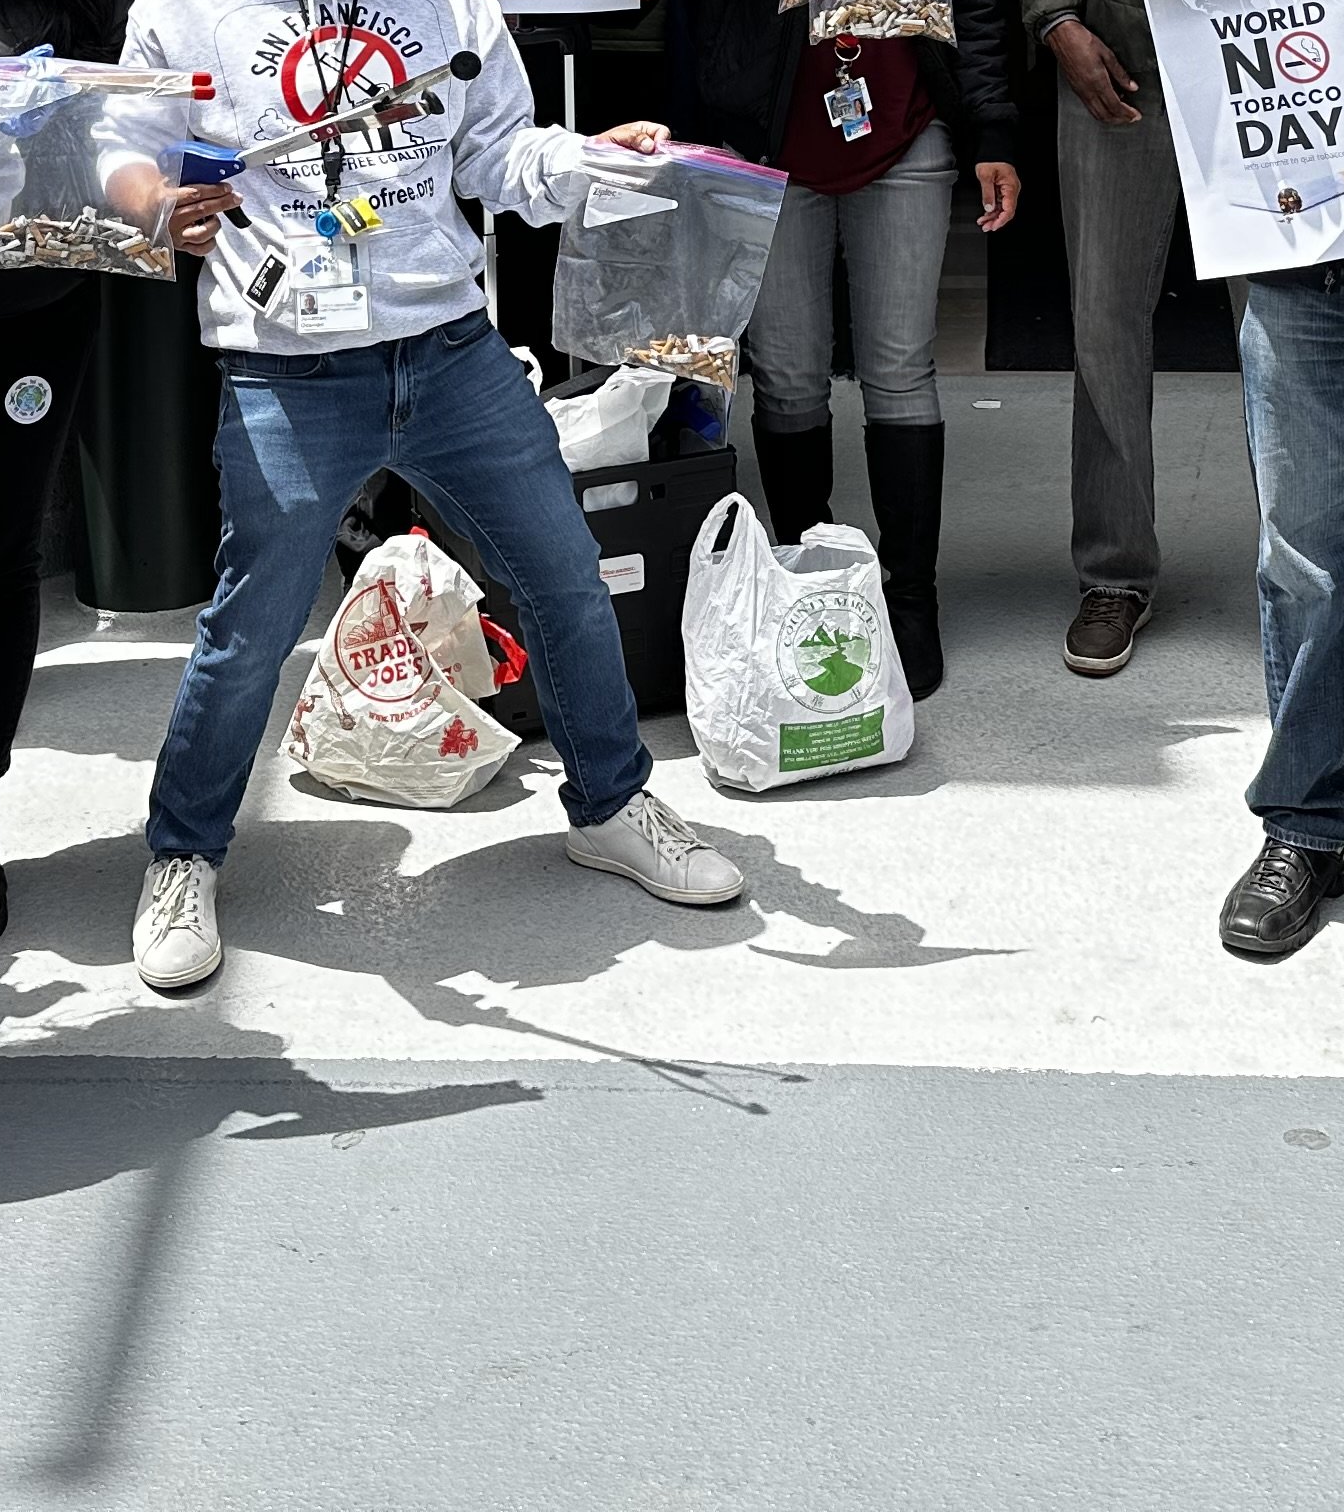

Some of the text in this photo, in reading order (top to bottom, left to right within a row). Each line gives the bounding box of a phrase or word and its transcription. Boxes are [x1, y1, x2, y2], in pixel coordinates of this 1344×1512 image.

[1210, 2, 1326, 40] WORLD
[251, 32, 290, 77] SAN
[1230, 86, 1342, 116] TOBACCO
[1236, 106, 1343, 159] DAY
[367, 656, 424, 688] JOE'S
